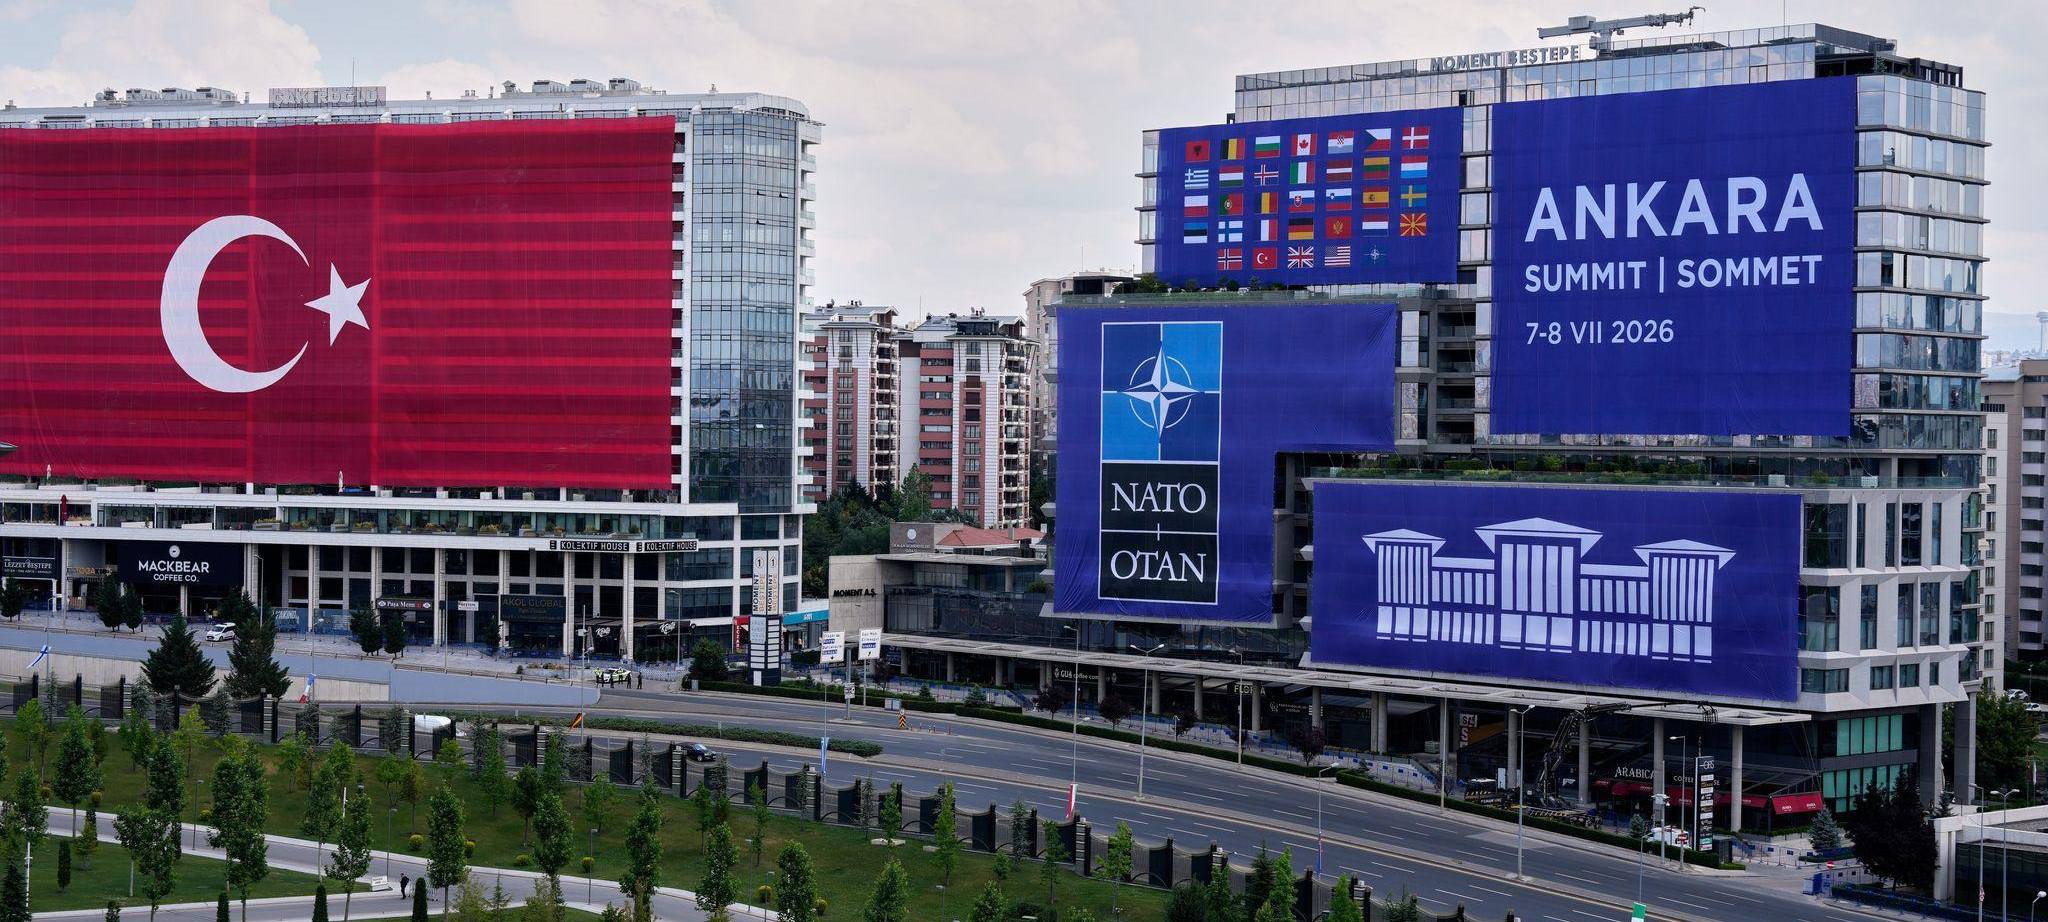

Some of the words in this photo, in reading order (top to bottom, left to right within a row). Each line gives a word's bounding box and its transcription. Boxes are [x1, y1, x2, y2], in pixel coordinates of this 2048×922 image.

[1430, 54, 1500, 72] MOMENT
[1507, 45, 1578, 65] BEŞTEPE
[1525, 173, 1824, 242] ANKARA
[1525, 261, 1647, 293] SUMMIT
[1677, 254, 1823, 288] SOMMET
[1526, 321, 1562, 345] 7-8
[1569, 321, 1602, 344] VII
[1611, 319, 1674, 344] 2026
[1111, 481, 1207, 514] NATO
[600, 542, 629, 552] HOUSE
[676, 541, 698, 551] HOUSE
[138, 560, 210, 573] MACKBEAR
[153, 574, 183, 582] COFFEE
[184, 574, 199, 583] CO.
[1110, 550, 1207, 583] OTAN
[833, 588, 863, 598] MOMENT
